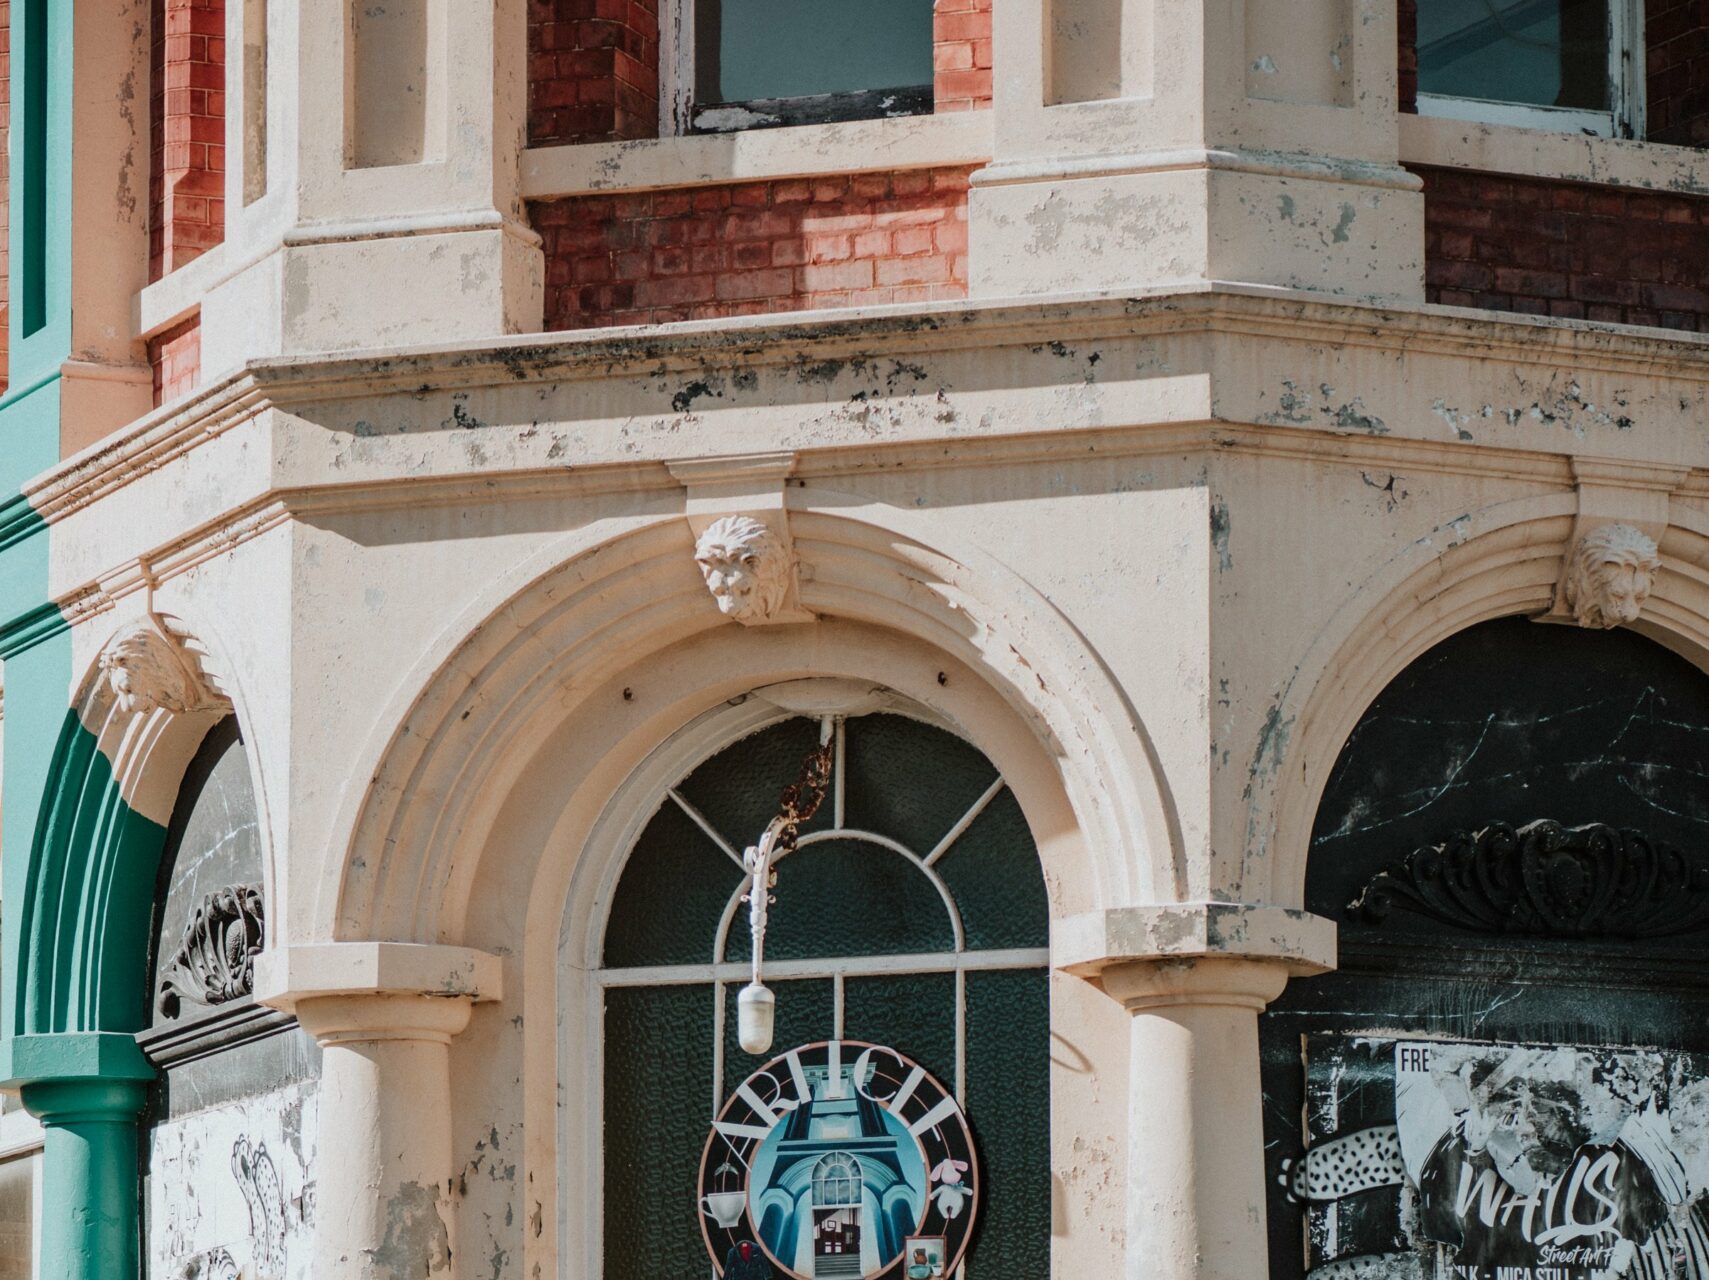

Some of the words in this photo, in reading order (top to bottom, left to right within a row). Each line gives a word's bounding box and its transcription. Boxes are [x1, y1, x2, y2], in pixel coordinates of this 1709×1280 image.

[711, 1040, 968, 1173] ARTICLE
[1537, 1245, 1578, 1266] Street
[1580, 1246, 1604, 1267] Art
